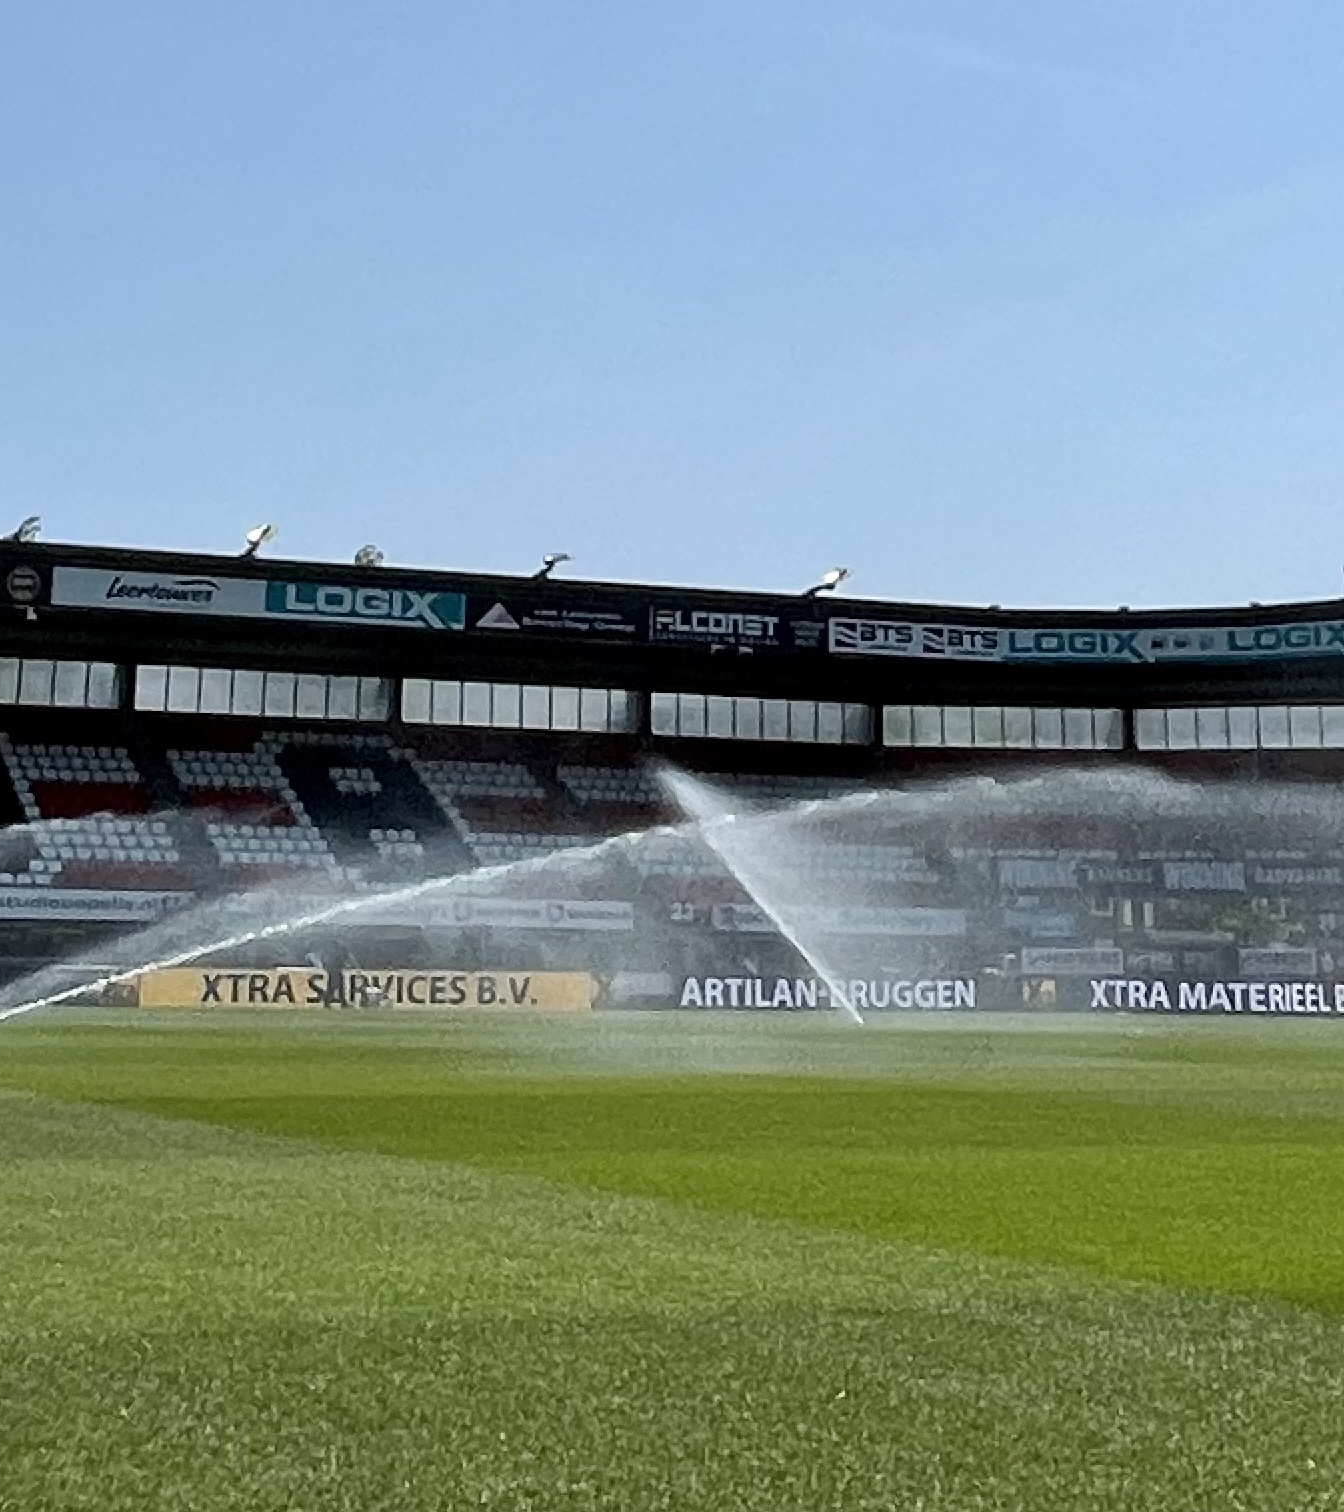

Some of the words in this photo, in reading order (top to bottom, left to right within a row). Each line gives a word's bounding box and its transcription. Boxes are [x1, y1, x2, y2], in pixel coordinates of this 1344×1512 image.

[285, 584, 444, 628] LOGIX
[1008, 630, 1148, 663] LOGIX
[200, 974, 296, 1005] XTRA
[306, 974, 466, 1006] SRVICES
[476, 975, 539, 1006] B.V.
[680, 976, 976, 1009] ARTILAN-BRUGGEN
[1090, 979, 1172, 1011] XTRA
[1178, 981, 1332, 1013] MATERIEEL
